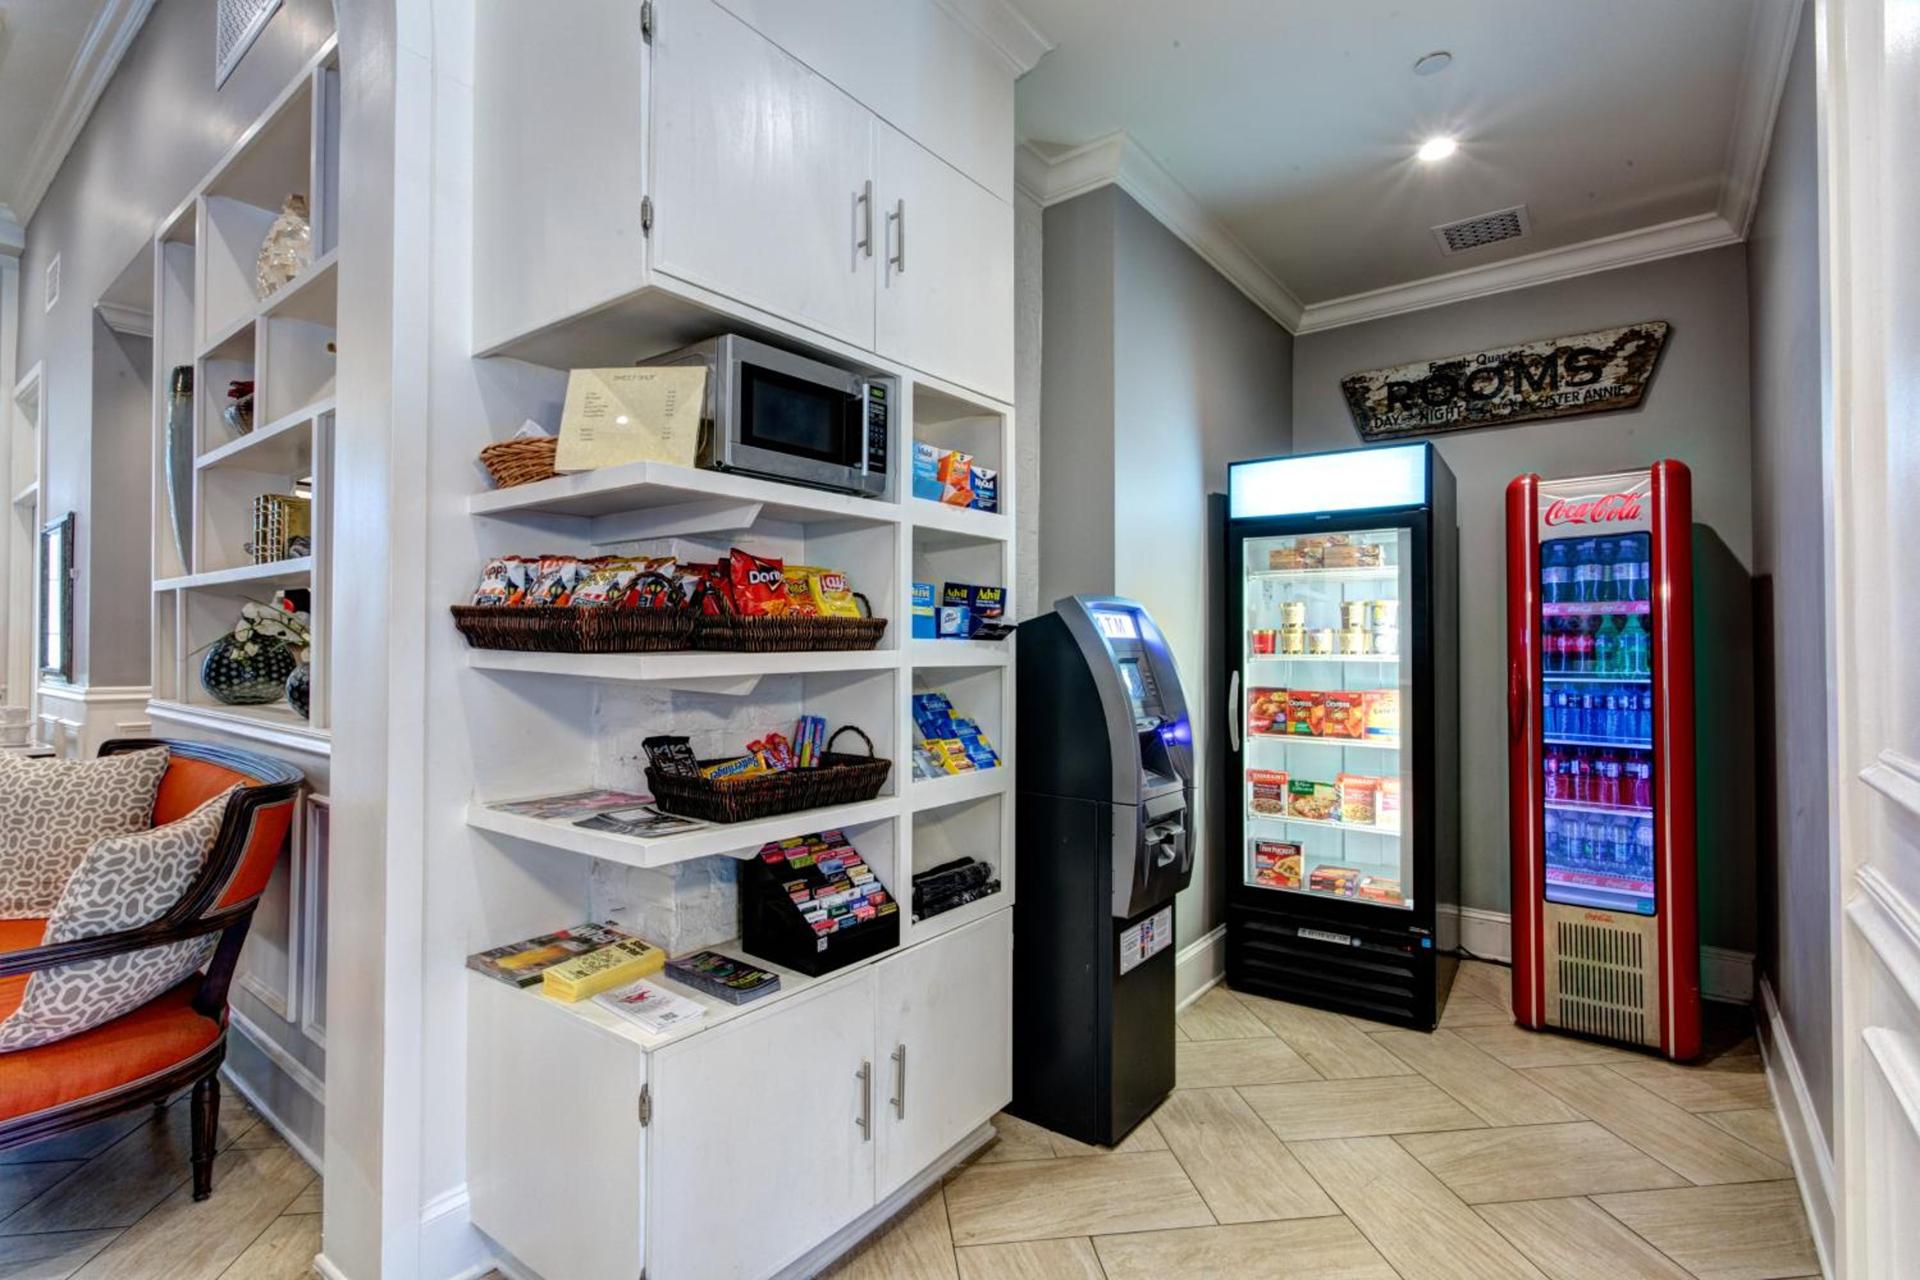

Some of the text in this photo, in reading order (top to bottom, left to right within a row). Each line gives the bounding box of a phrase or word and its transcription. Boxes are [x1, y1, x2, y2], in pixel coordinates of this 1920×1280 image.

[1386, 347, 1602, 412] ROOMS
[1584, 385, 1625, 401] ANNIE
[1374, 405, 1462, 429] DAY NIGHT
[1544, 492, 1640, 526] Coca-Cola
[946, 587, 968, 599] Advil
[979, 588, 1001, 600] Advil
